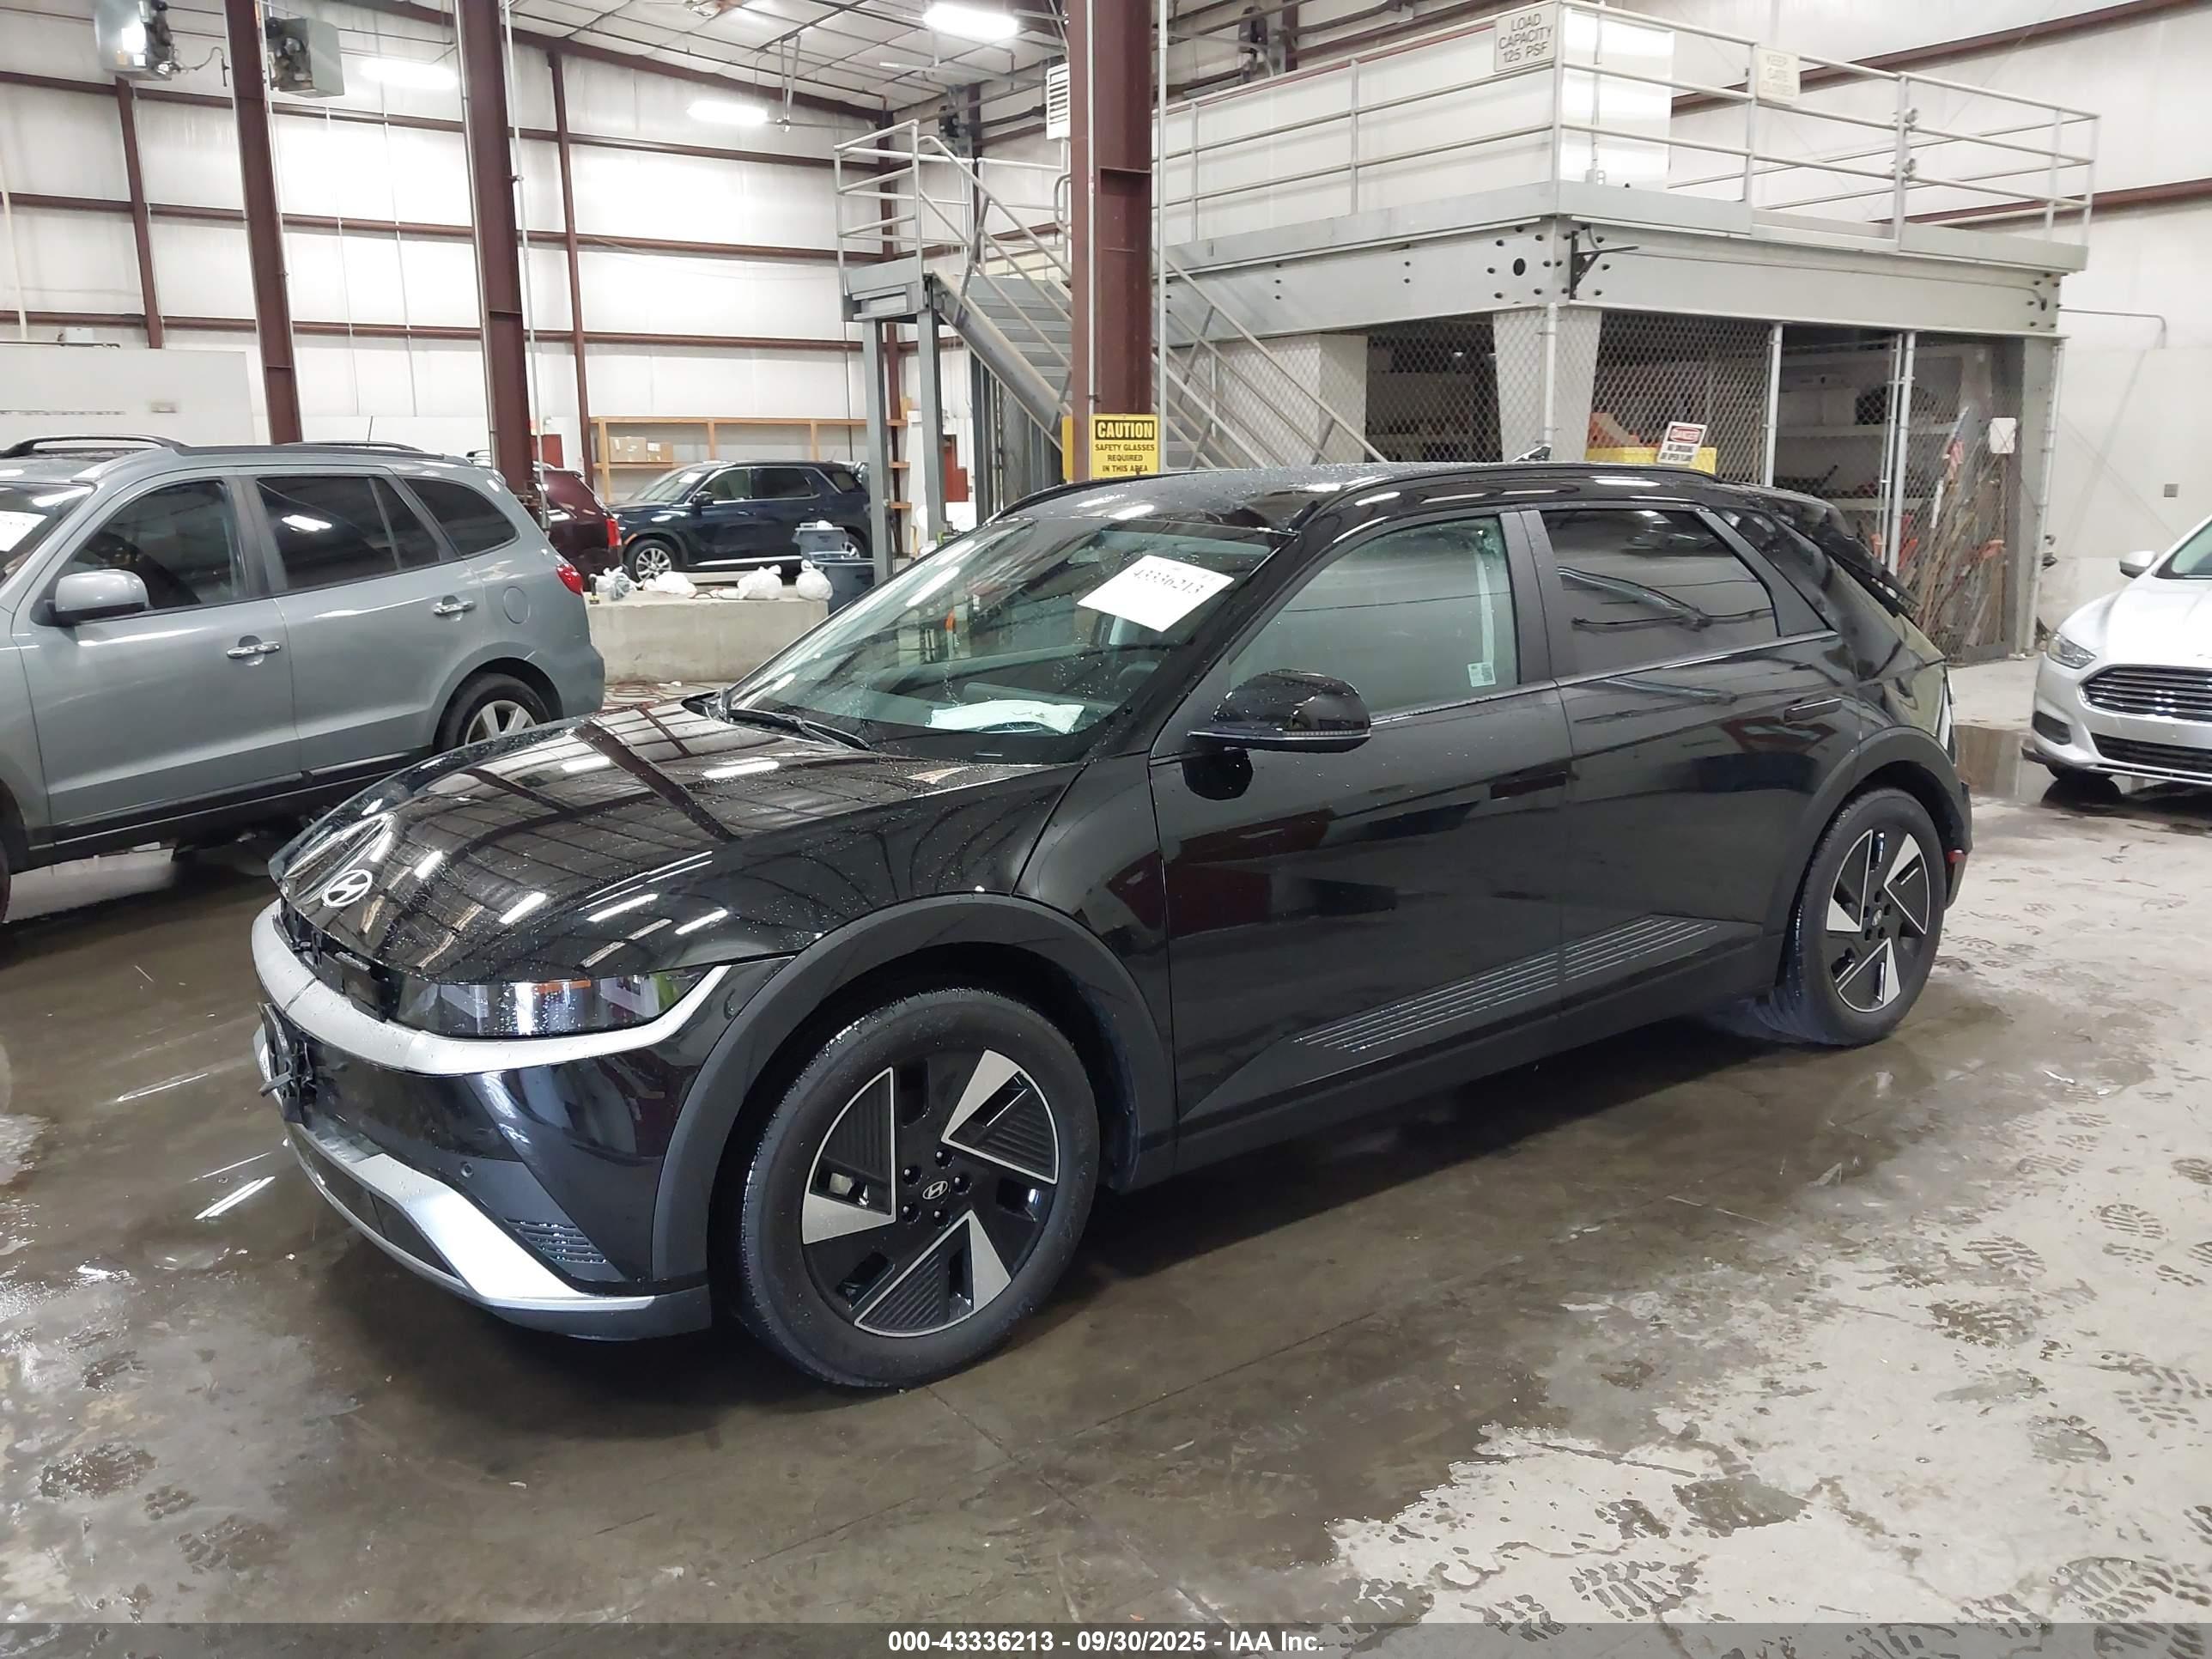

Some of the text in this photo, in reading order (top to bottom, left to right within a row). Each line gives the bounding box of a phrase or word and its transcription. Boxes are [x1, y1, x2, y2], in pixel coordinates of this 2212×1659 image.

[1511, 13, 1542, 32] LOAD
[1498, 24, 1553, 50] CAPACITY
[1503, 40, 1548, 63] 125 PSF
[1097, 422, 1153, 438] CAUTION
